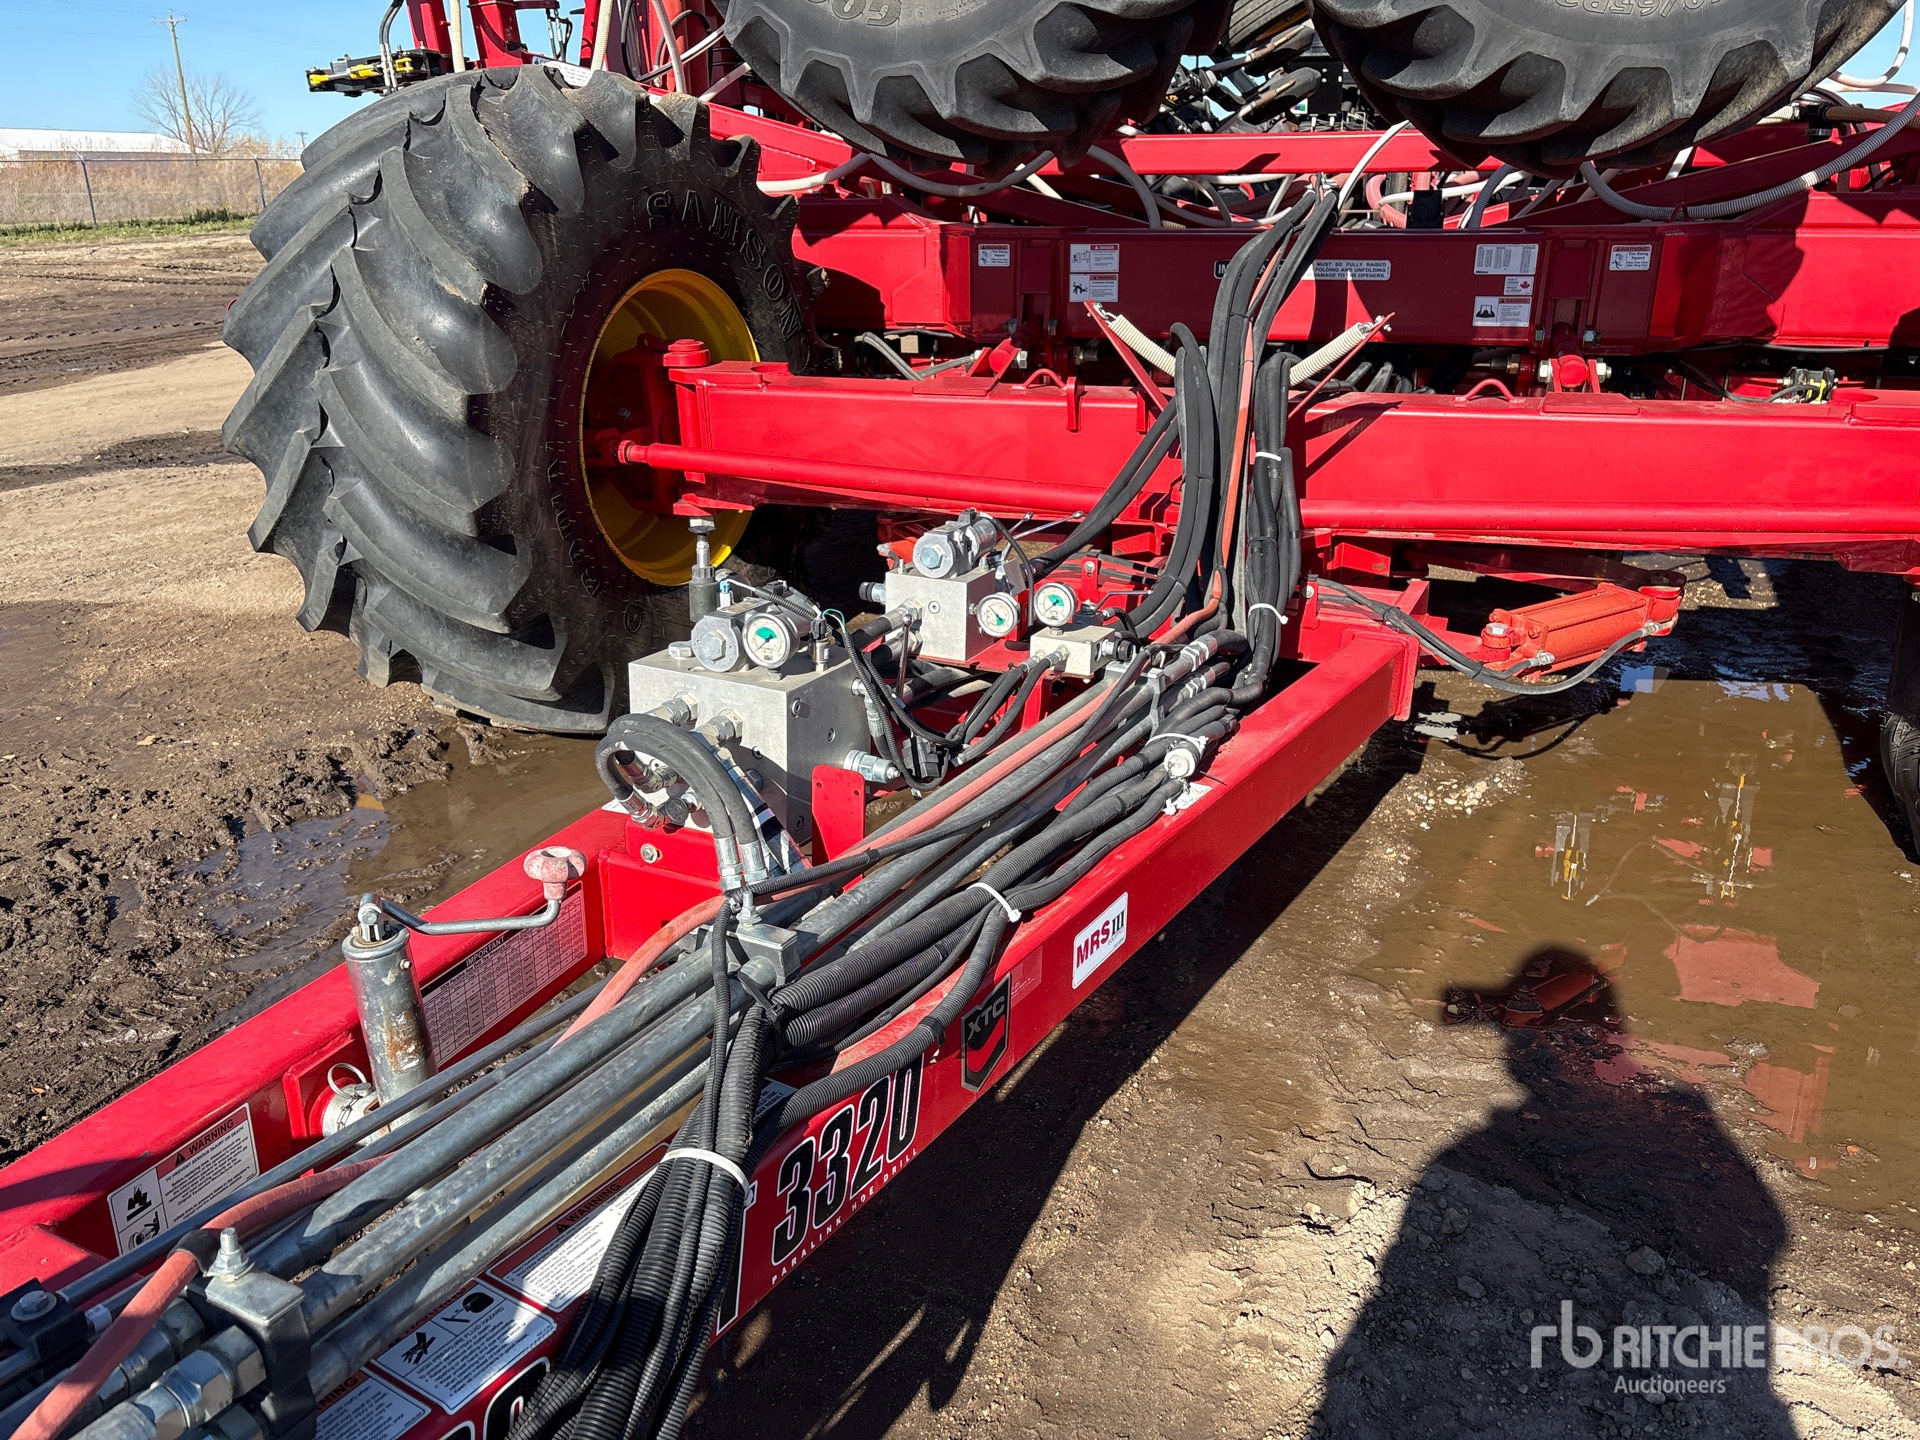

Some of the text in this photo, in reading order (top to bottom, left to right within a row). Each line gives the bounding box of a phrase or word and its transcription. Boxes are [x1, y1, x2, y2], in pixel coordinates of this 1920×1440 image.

[646, 189, 803, 342] SAMSON
[466, 936, 505, 966] IMPORTANT
[1076, 920, 1110, 969] MRS
[1112, 909, 1125, 936] III
[967, 995, 1005, 1041] XTC
[189, 1119, 234, 1155] WARNING
[772, 1052, 925, 1267] 3320
[565, 1183, 622, 1224] WARNING
[772, 1148, 918, 1285] PARALINK HOE DRILL
